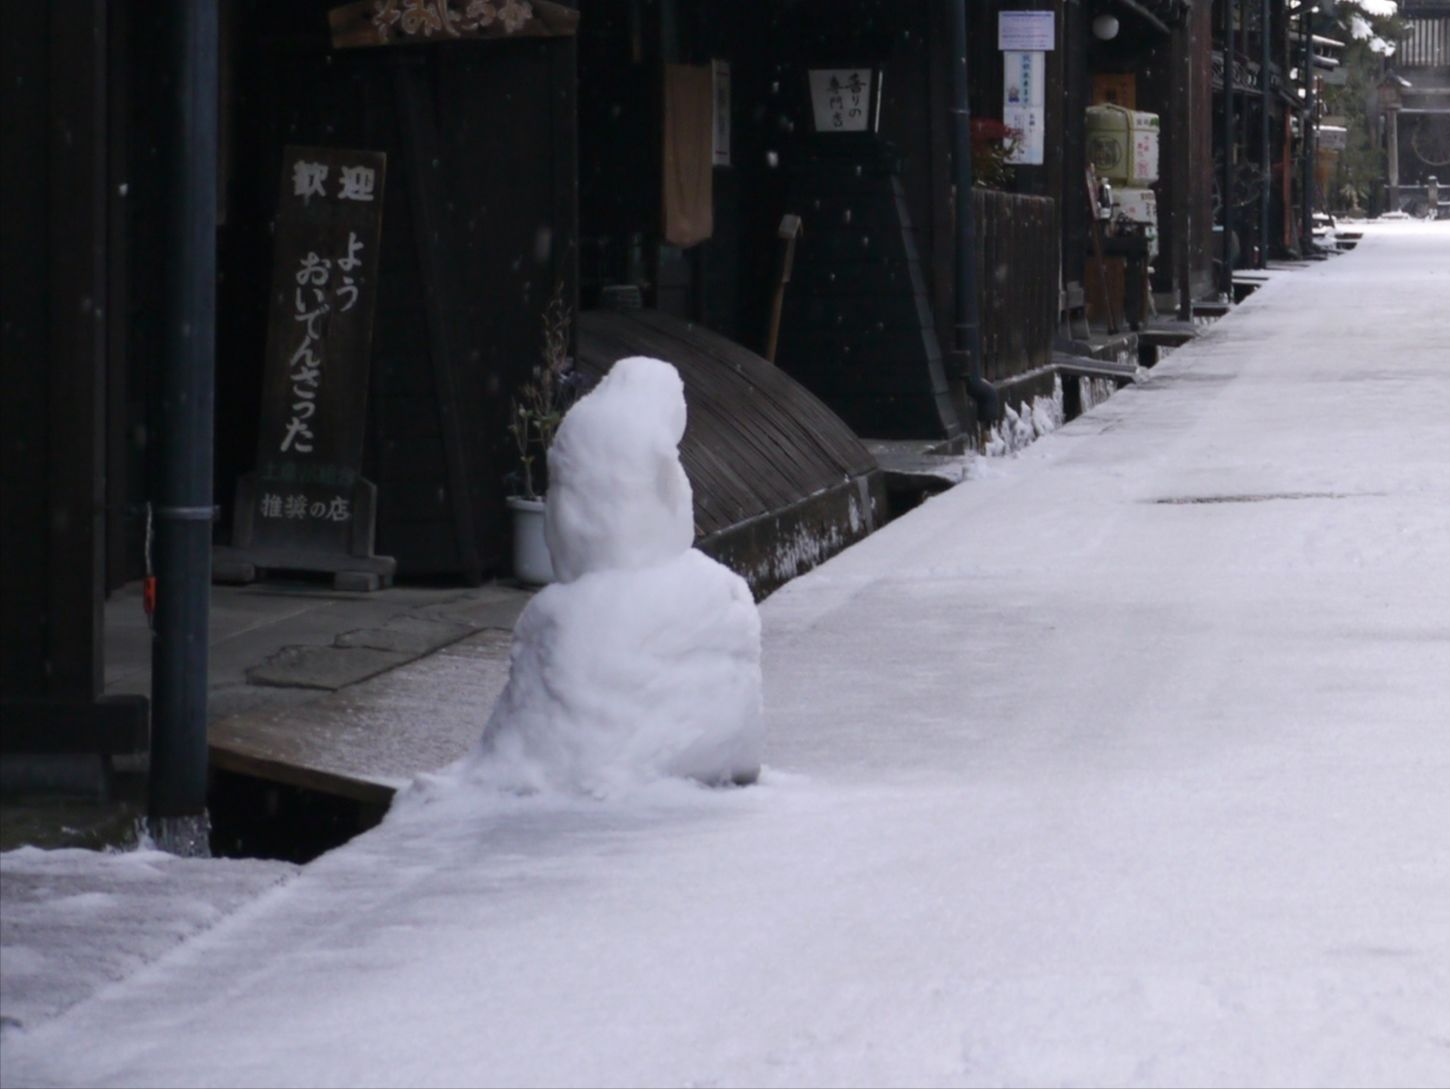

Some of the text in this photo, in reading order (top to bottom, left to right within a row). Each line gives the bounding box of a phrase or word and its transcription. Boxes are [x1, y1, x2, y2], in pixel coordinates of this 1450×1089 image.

[337, 232, 363, 312] よう
[281, 252, 330, 453] おいでんさった
